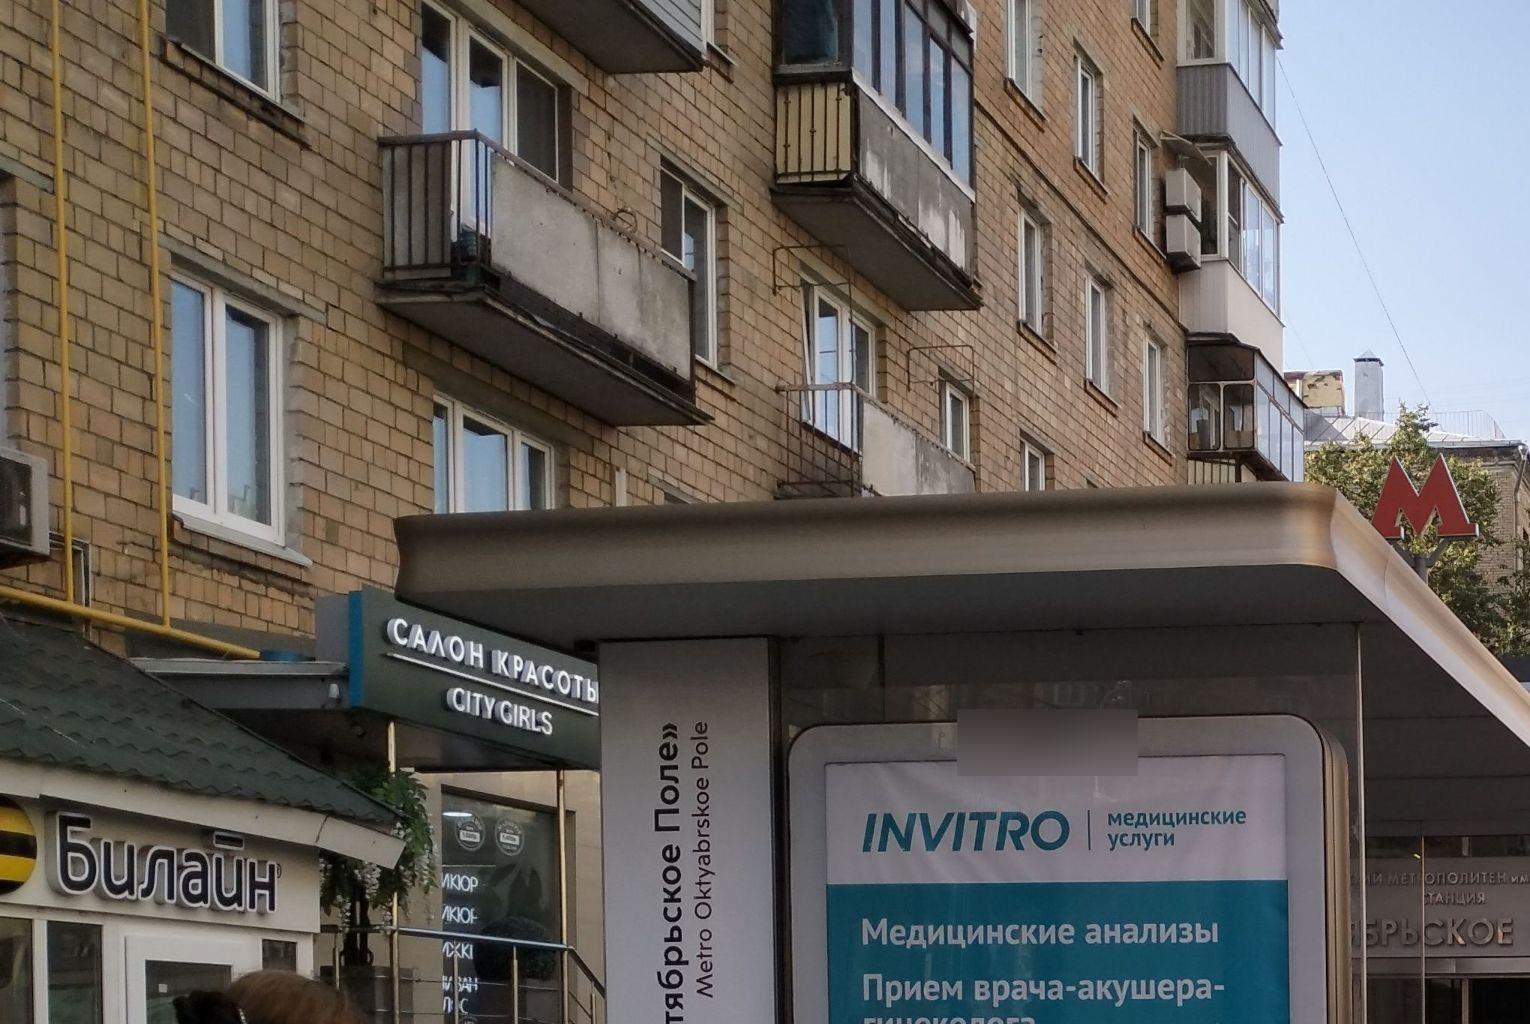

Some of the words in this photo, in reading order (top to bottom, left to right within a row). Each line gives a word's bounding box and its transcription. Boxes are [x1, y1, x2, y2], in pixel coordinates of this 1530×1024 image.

[387, 617, 484, 669] САЛОН
[447, 687, 496, 720] CITY
[495, 700, 554, 736] GIRLS
[690, 721, 709, 769] Pole
[654, 722, 681, 832] Поле»
[861, 809, 1070, 853] INVITRO
[1107, 806, 1247, 828] медицинские
[1107, 829, 1175, 851] услуги
[56, 811, 279, 914] Билайн
[691, 777, 716, 920] Oktyabrskoe
[1388, 871, 1507, 886] МЕТОПОЛИТЕН
[862, 916, 1075, 949] Медицинские
[1084, 920, 1219, 944] анализы
[695, 928, 714, 998] Metro
[862, 973, 963, 1007] Прием
[973, 976, 1225, 1009] врача-акушера-
